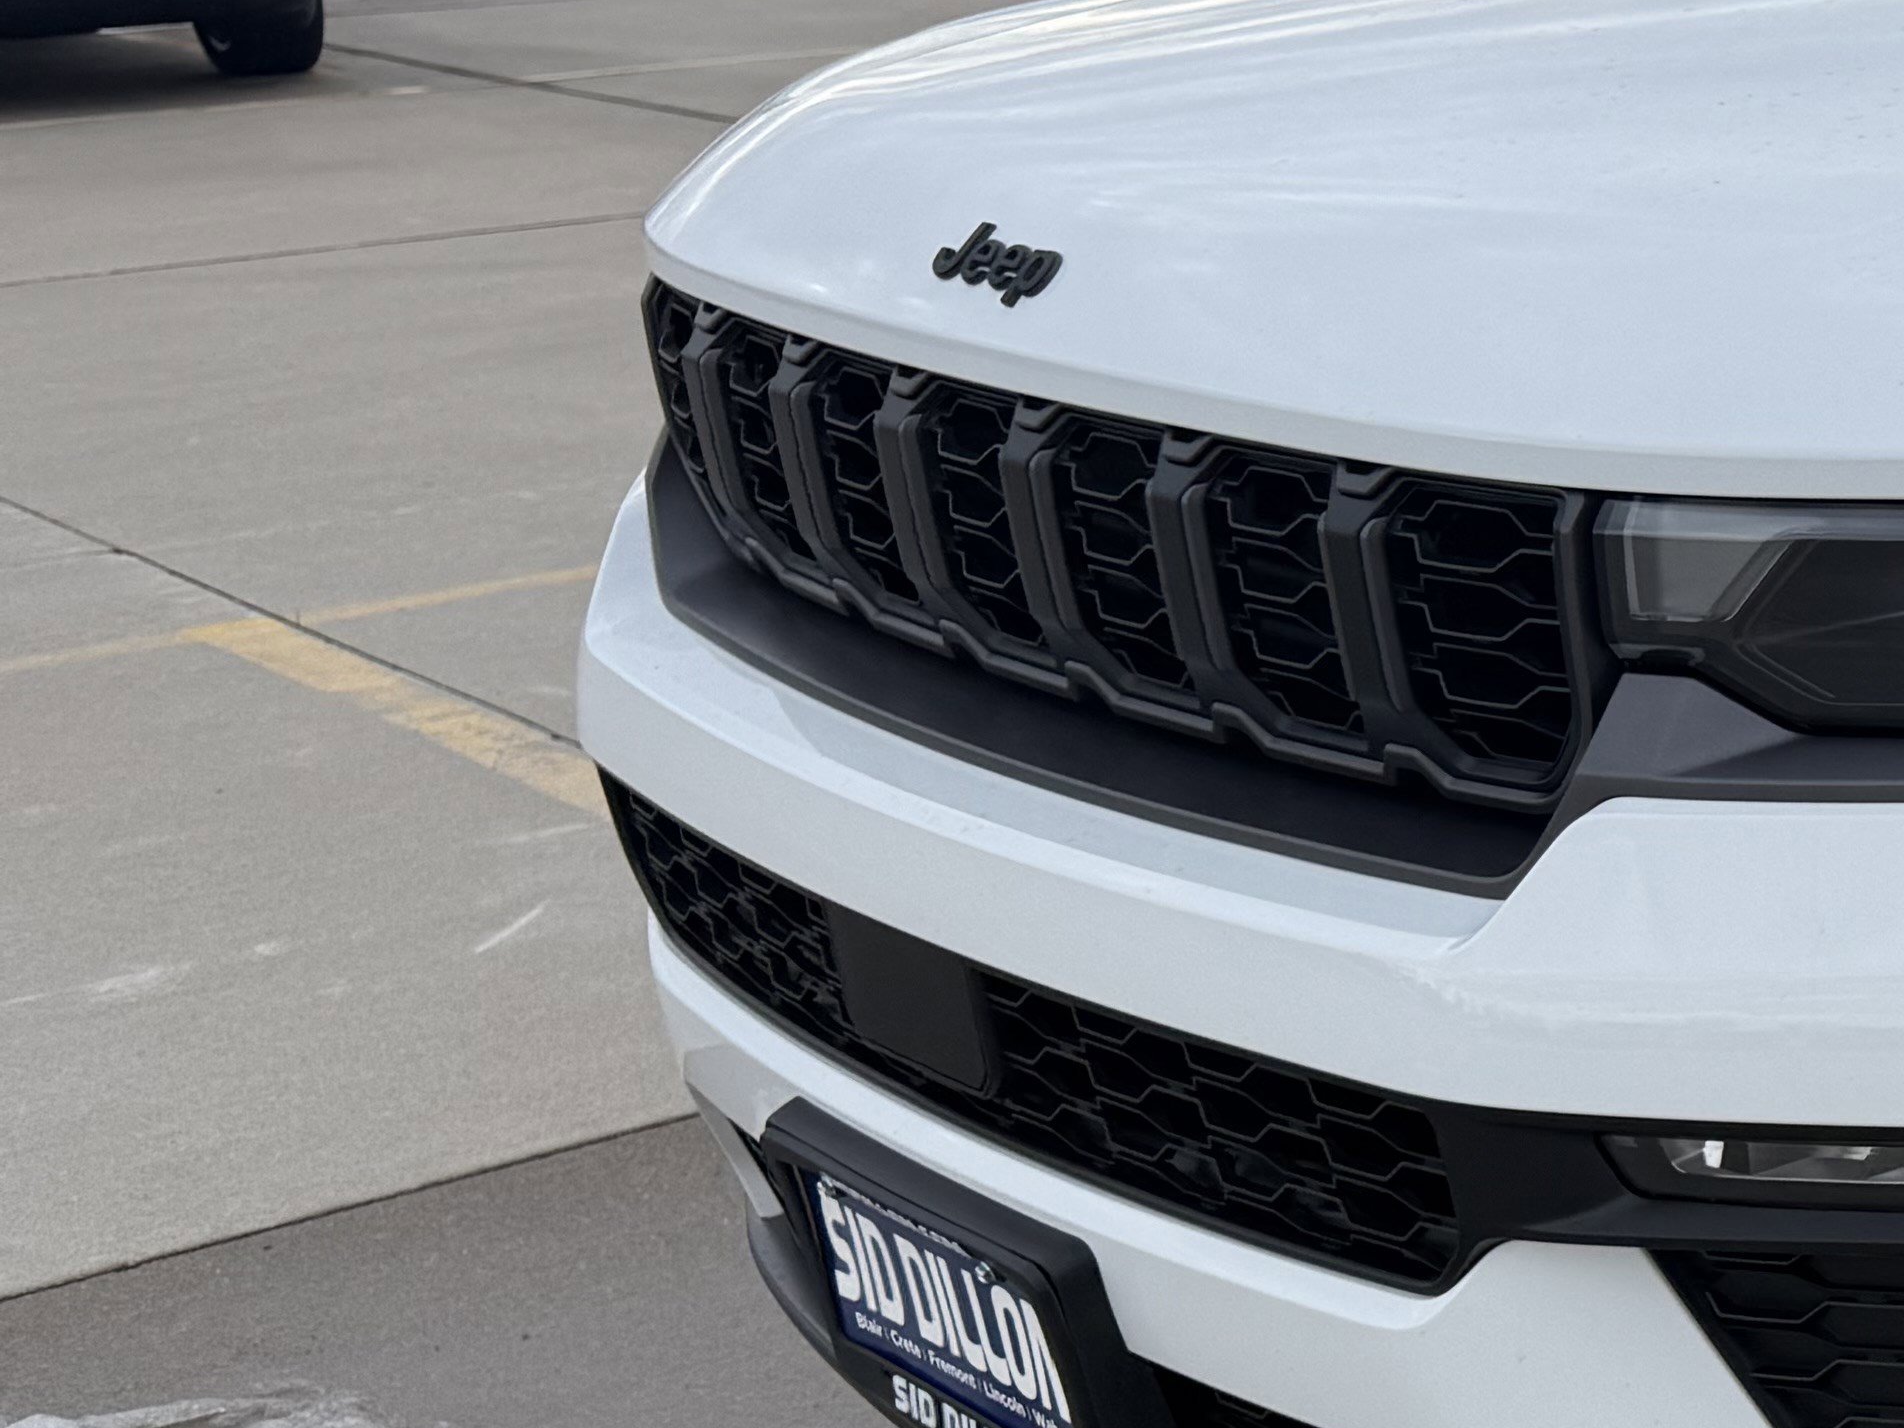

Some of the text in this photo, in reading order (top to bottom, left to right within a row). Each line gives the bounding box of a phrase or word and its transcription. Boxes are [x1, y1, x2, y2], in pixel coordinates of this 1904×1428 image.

[931, 222, 1064, 308] Jeep
[819, 1190, 905, 1326] SID
[893, 1234, 1072, 1424] DILLON
[855, 1312, 883, 1338] Blair
[928, 1348, 977, 1390] Fremont
[983, 1379, 1027, 1418] Lincoln
